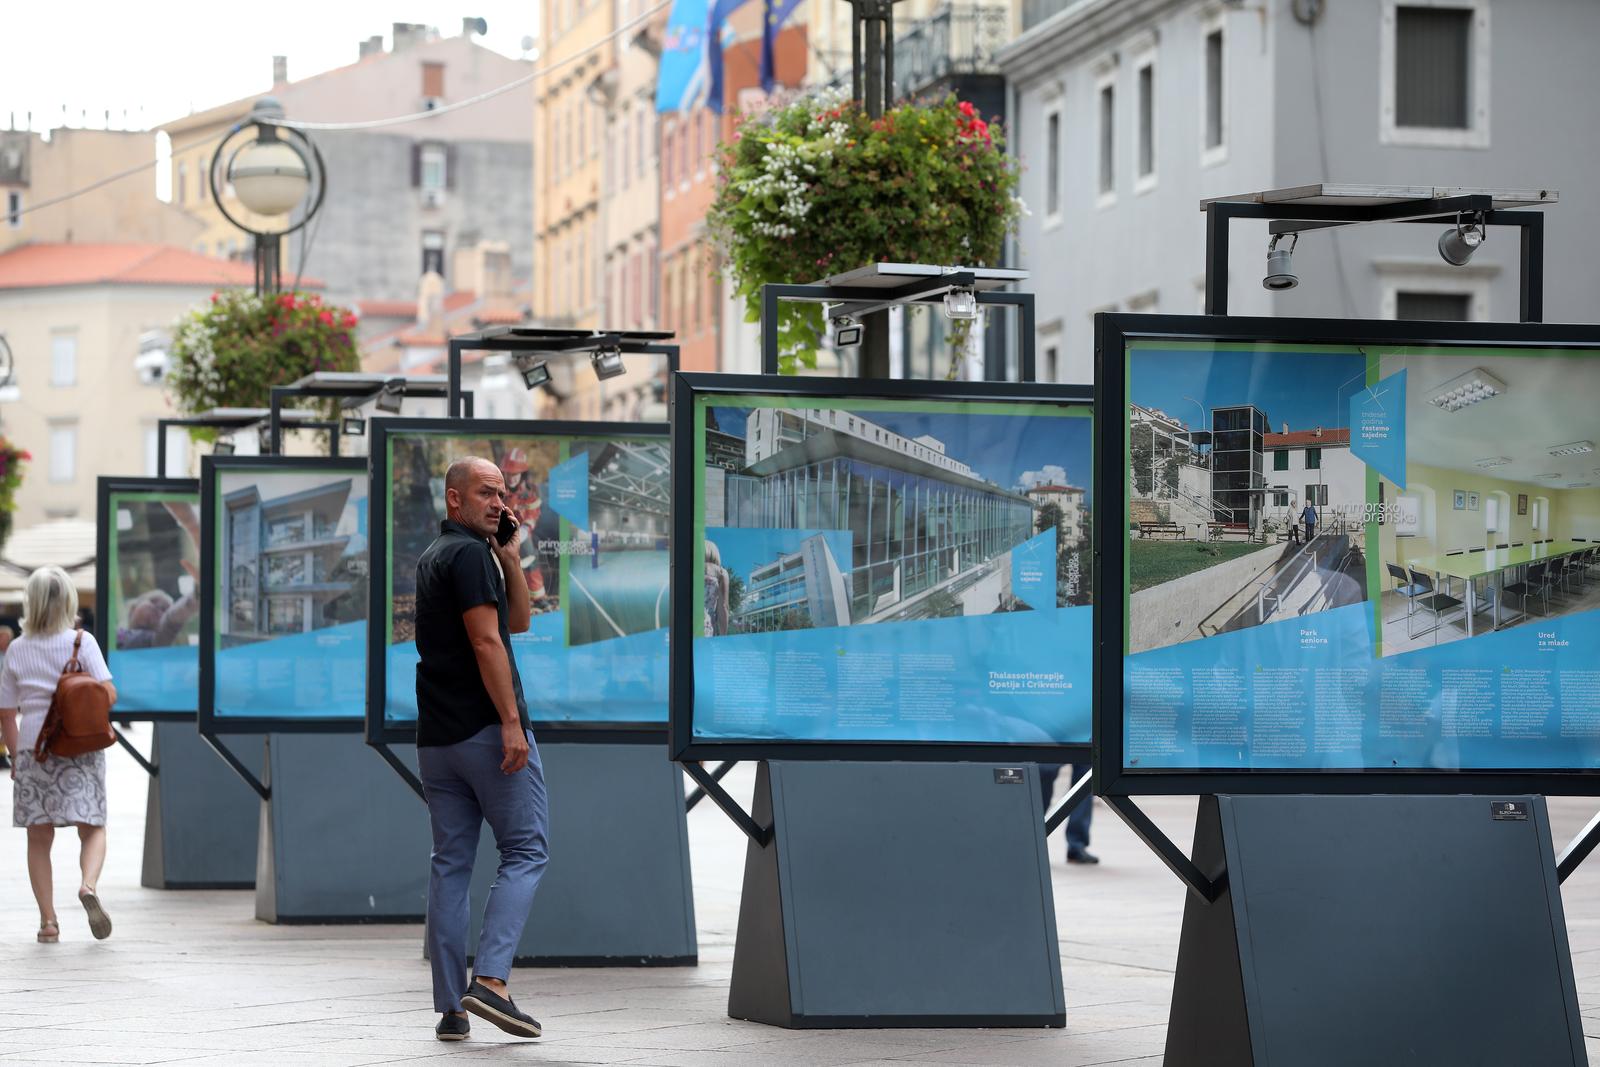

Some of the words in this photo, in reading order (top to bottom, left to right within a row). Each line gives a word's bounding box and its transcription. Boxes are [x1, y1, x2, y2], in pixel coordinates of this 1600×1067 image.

[1361, 432, 1388, 440] zajedno
[988, 680, 1021, 690] Opatija
[1026, 680, 1073, 690] Crikvenica
